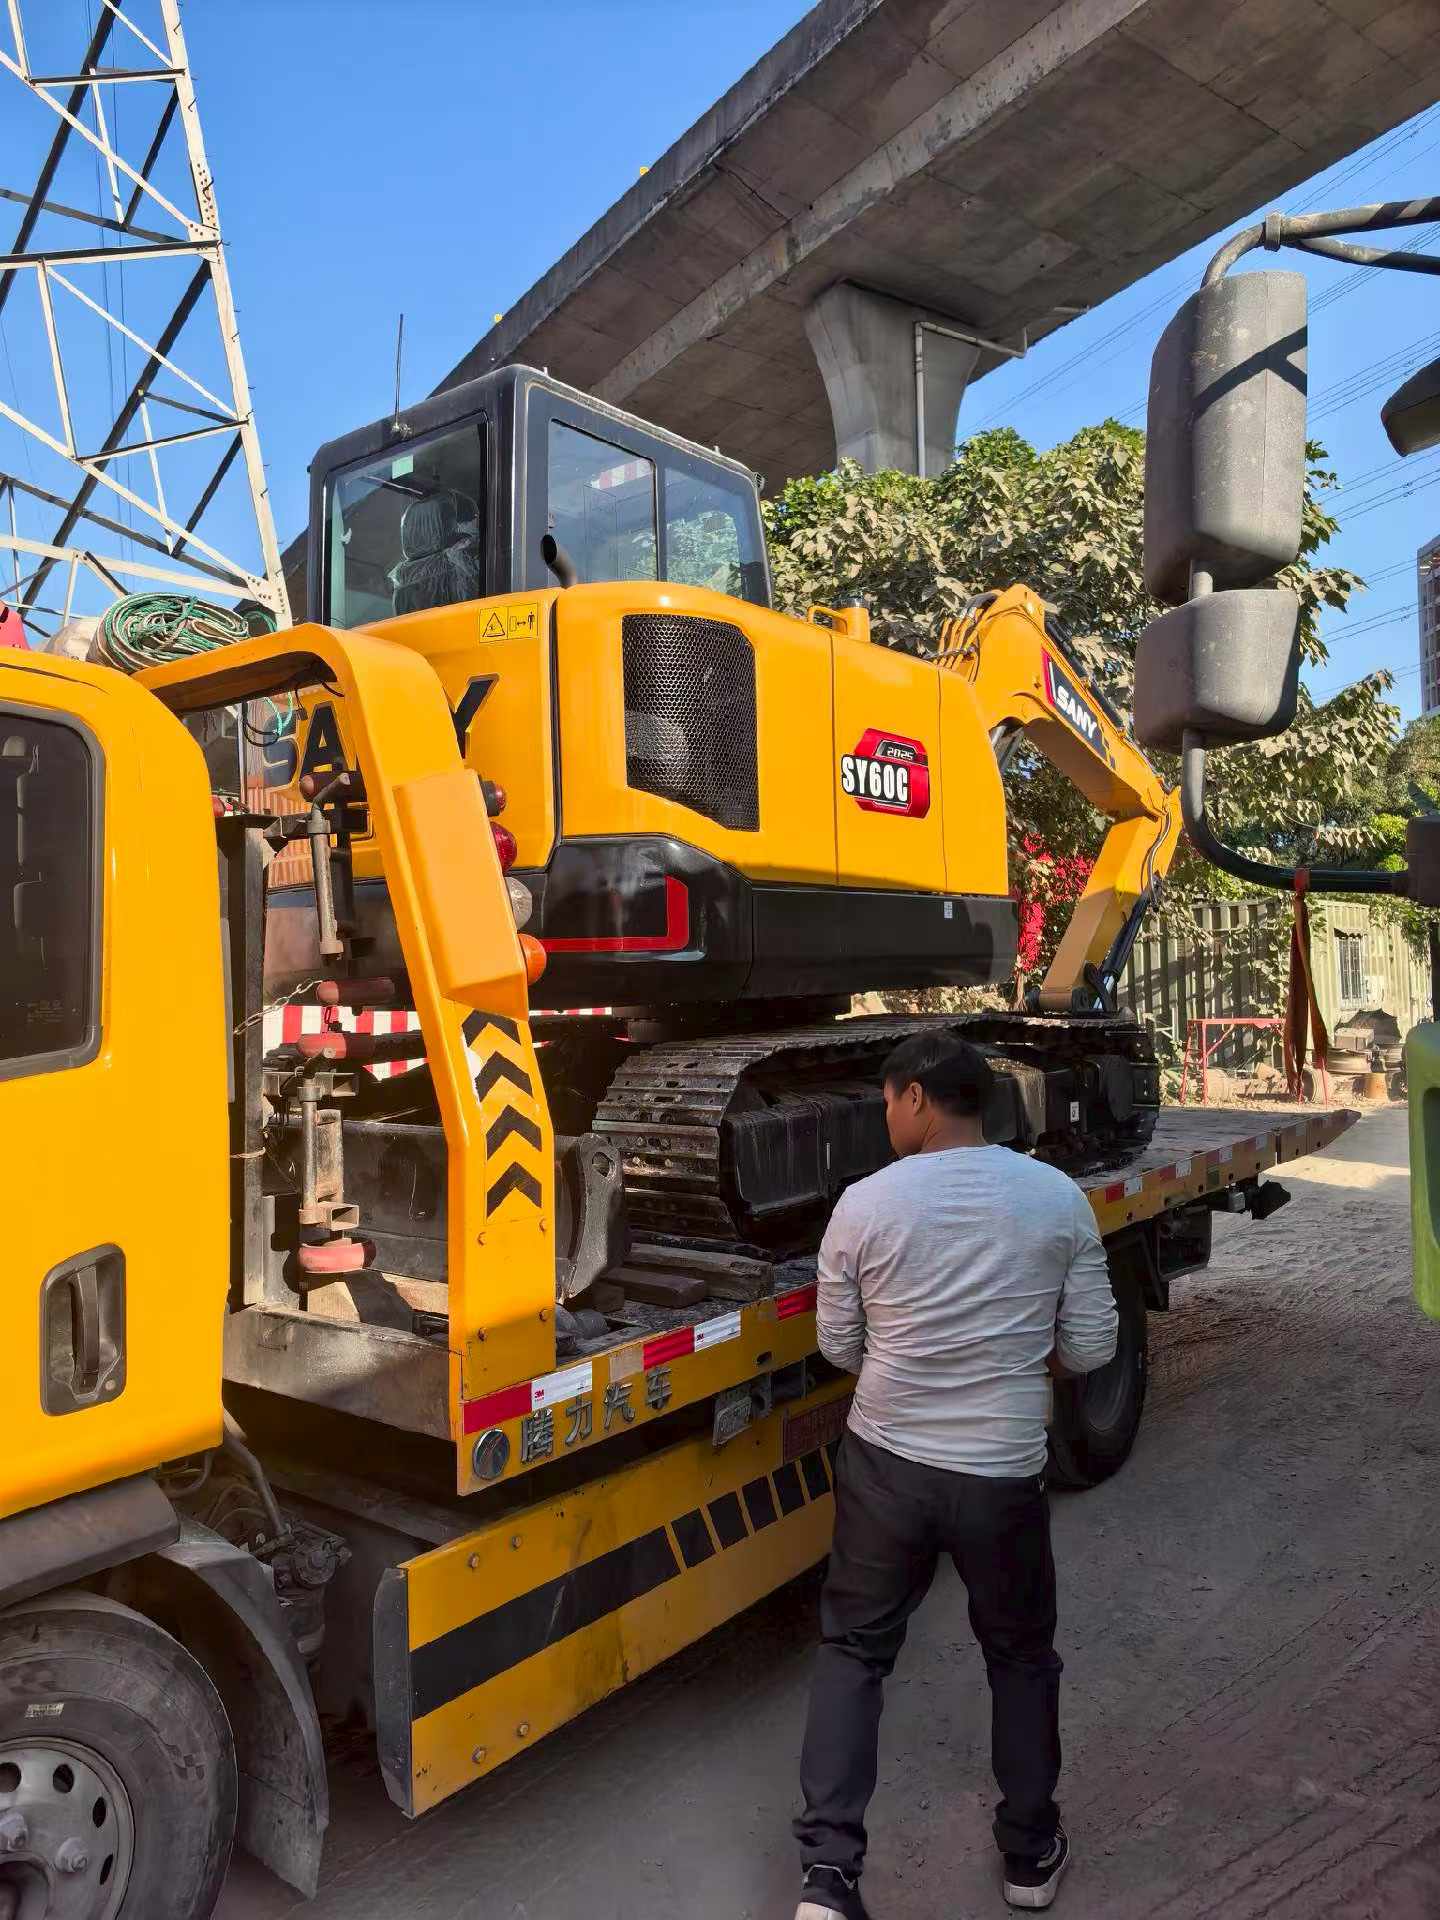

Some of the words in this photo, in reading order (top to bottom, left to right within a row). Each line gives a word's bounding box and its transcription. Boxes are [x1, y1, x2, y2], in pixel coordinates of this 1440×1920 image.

[1055, 685, 1098, 739] SANY
[887, 746, 914, 761] 2025
[841, 756, 908, 803] SY60C
[534, 1389, 545, 1399] 3M
